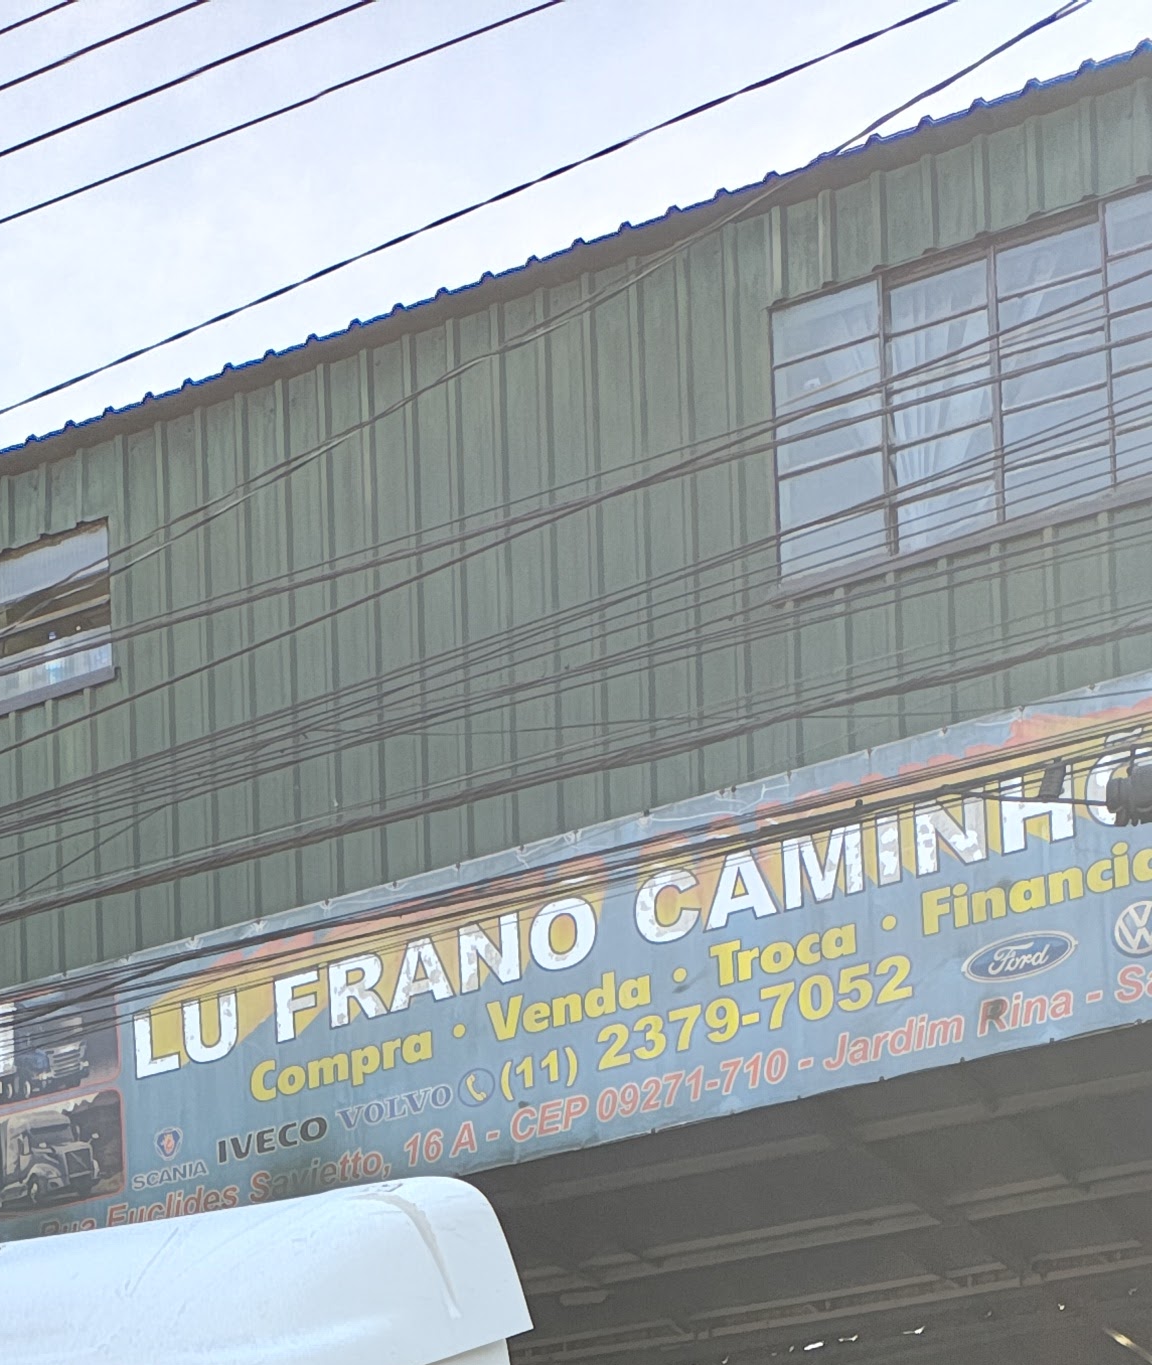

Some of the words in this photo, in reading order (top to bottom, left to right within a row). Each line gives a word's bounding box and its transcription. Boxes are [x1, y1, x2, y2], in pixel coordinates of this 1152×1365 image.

[133, 990, 238, 1079] LU
[273, 896, 597, 1043] FRANO
[250, 1031, 433, 1101] Compra
[486, 972, 651, 1041] Venda
[709, 923, 857, 986] Troca
[500, 1047, 578, 1100] (11)
[596, 955, 913, 1071] 2379-7052
[987, 941, 1050, 976] Ford
[217, 1115, 329, 1165] IVECO
[336, 1084, 453, 1131] VOLVO
[249, 1147, 392, 1204] Savietto,
[403, 1127, 445, 1169] 16
[449, 1119, 478, 1159] A
[510, 1095, 589, 1142] CEP
[596, 1048, 788, 1122] 09271-710
[823, 1013, 965, 1071] Jardim
[977, 989, 1073, 1037] Rina
[1114, 964, 1152, 1003] S
[132, 1160, 209, 1191] SCANIA
